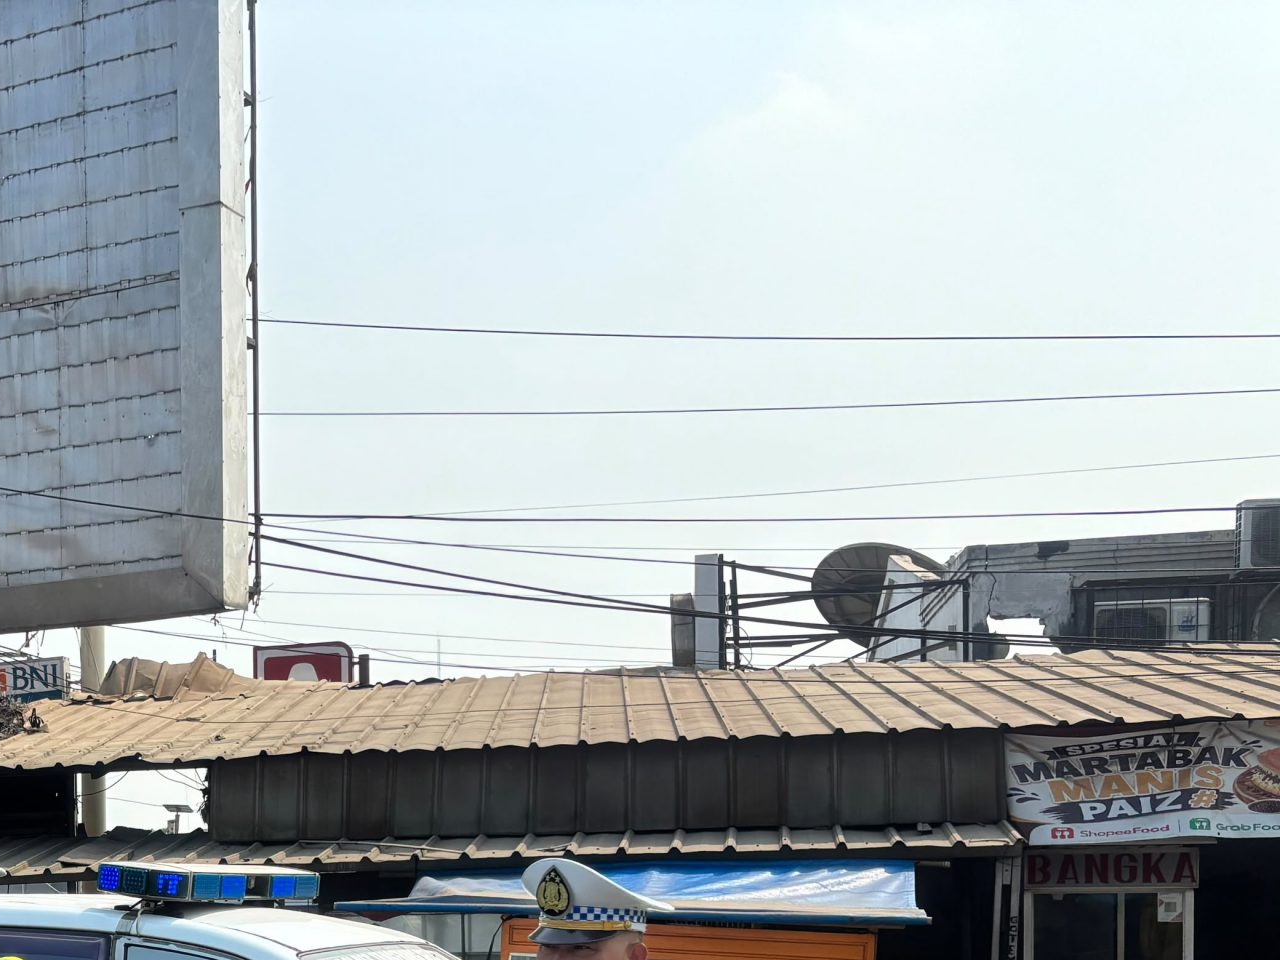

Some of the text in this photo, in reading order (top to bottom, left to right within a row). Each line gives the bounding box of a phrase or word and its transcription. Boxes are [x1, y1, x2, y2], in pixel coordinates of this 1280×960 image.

[11, 663, 57, 690] BNI
[1065, 733, 1186, 756] SPESIAL
[1011, 747, 1254, 784] MARTABAK
[1048, 765, 1224, 804] MANIS
[1079, 791, 1182, 821] PAIZ
[1080, 823, 1170, 838] ShopeeFood
[1027, 852, 1197, 886] BANGKA
